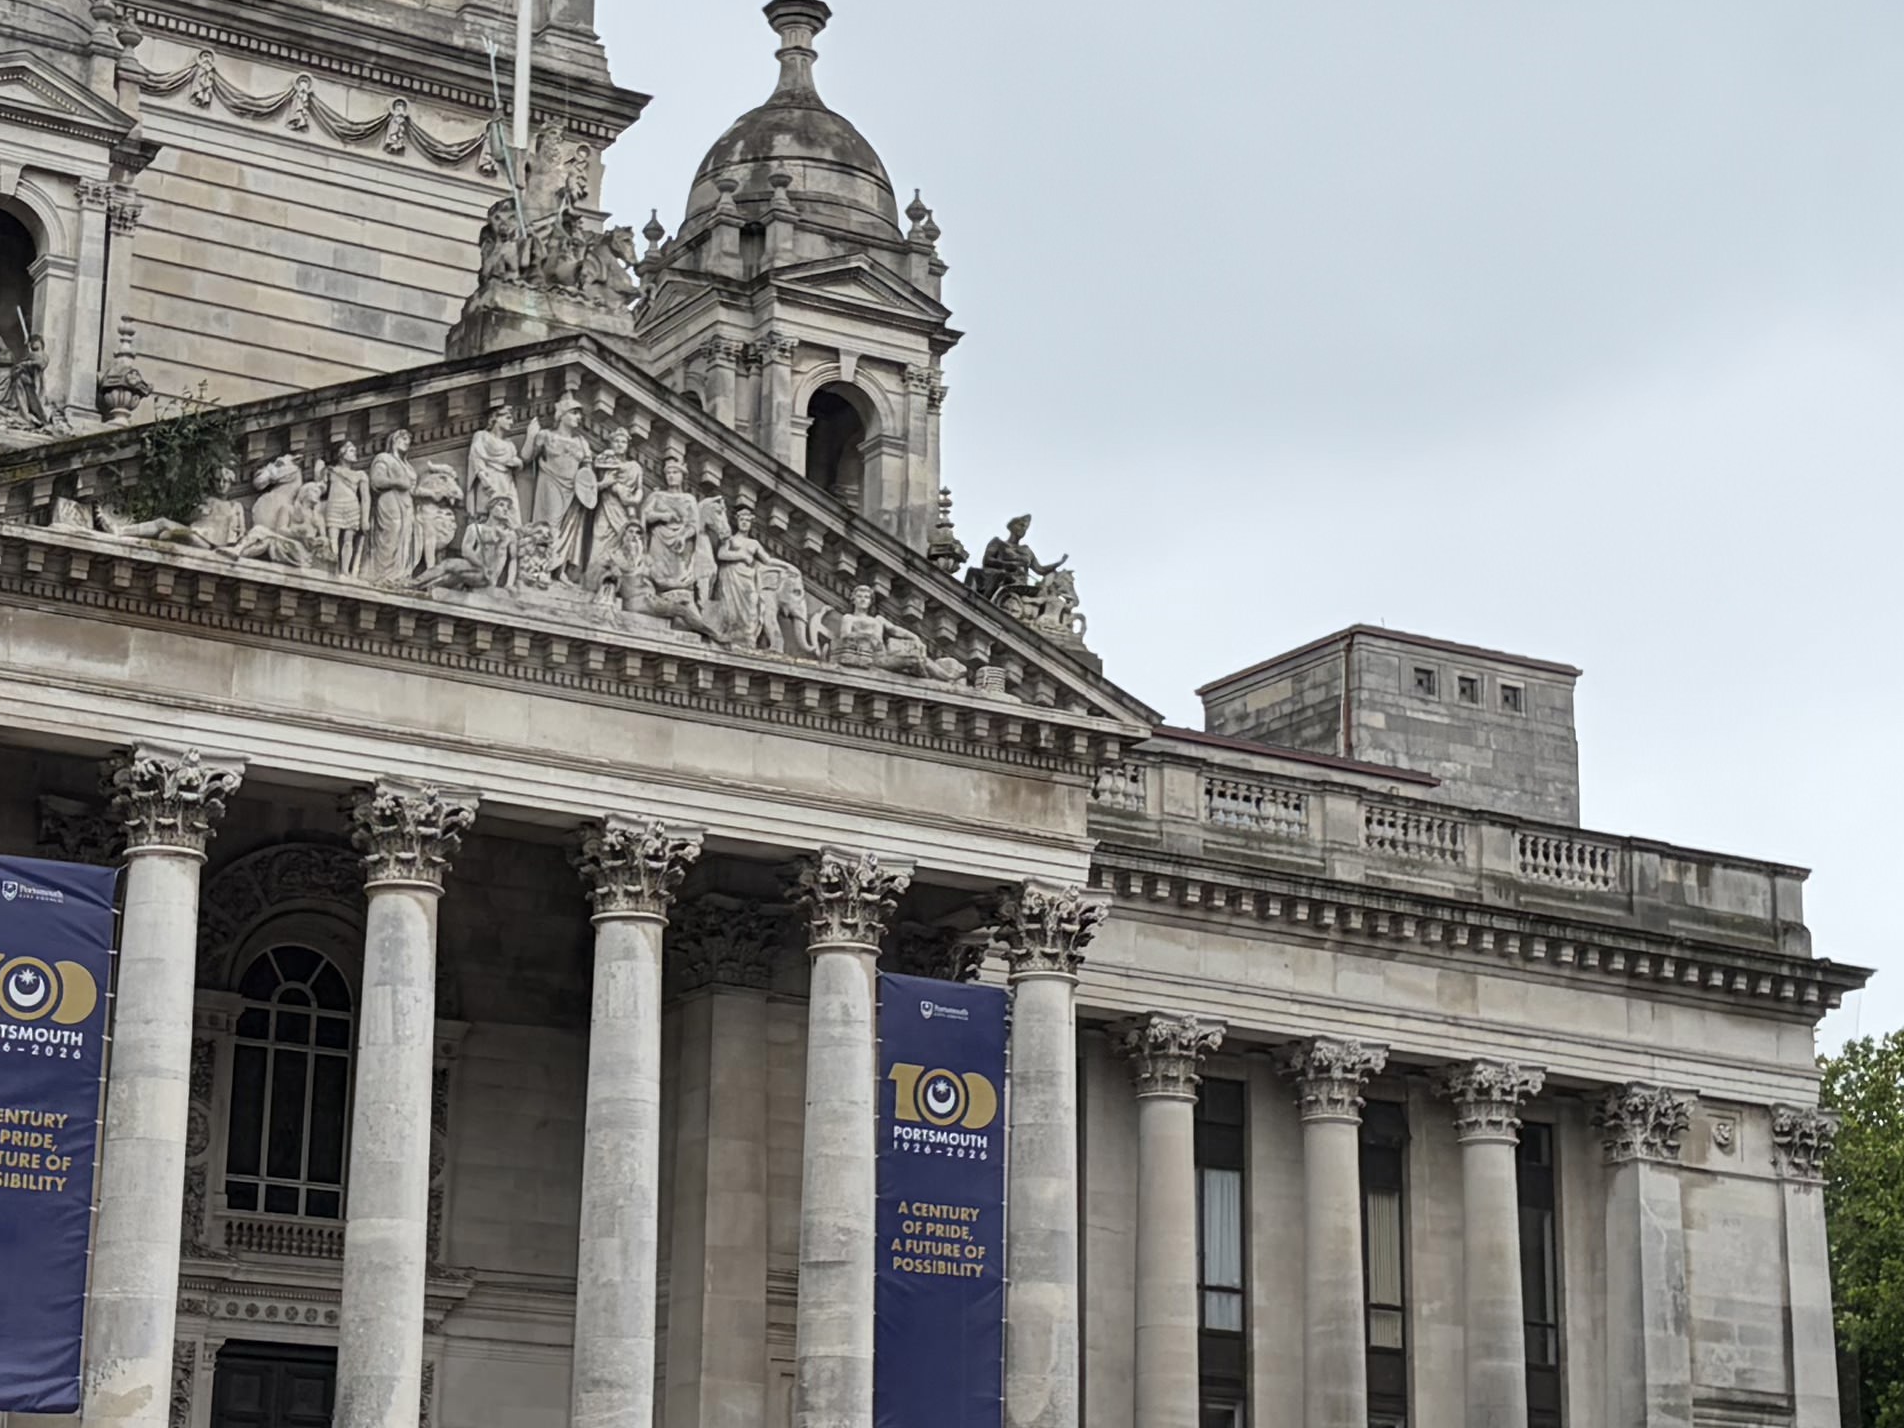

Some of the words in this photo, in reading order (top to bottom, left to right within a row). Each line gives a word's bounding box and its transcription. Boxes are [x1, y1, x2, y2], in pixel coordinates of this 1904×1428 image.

[887, 1062, 998, 1129] 100
[0, 1128, 58, 1152] PRIDE,
[893, 1125, 988, 1149] PORTSMOUTH
[45, 1154, 72, 1171] OF
[897, 1200, 909, 1214] A
[911, 1202, 980, 1222] CENTURY
[902, 1220, 923, 1234] OF
[925, 1222, 974, 1243] PRIDE,
[891, 1238, 903, 1252] A
[905, 1239, 961, 1258] FUTURE
[964, 1245, 986, 1260] OF
[892, 1256, 984, 1278] POSSIBILITY
